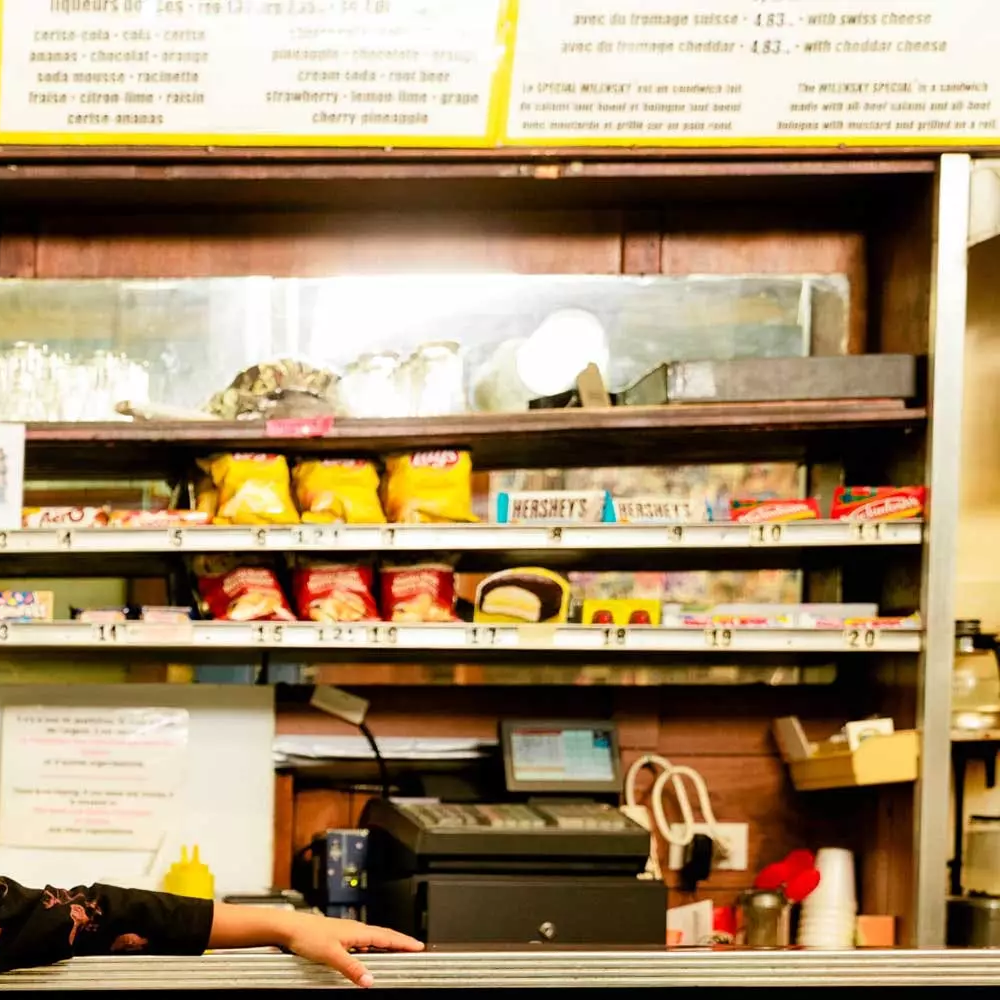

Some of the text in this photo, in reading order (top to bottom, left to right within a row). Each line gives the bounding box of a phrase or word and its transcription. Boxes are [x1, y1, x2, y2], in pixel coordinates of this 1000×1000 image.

[840, 13, 877, 25] swiss
[881, 12, 932, 25] cheese
[804, 40, 831, 52] with
[897, 40, 947, 52] cheese
[513, 498, 587, 519] HERSHEY'S
